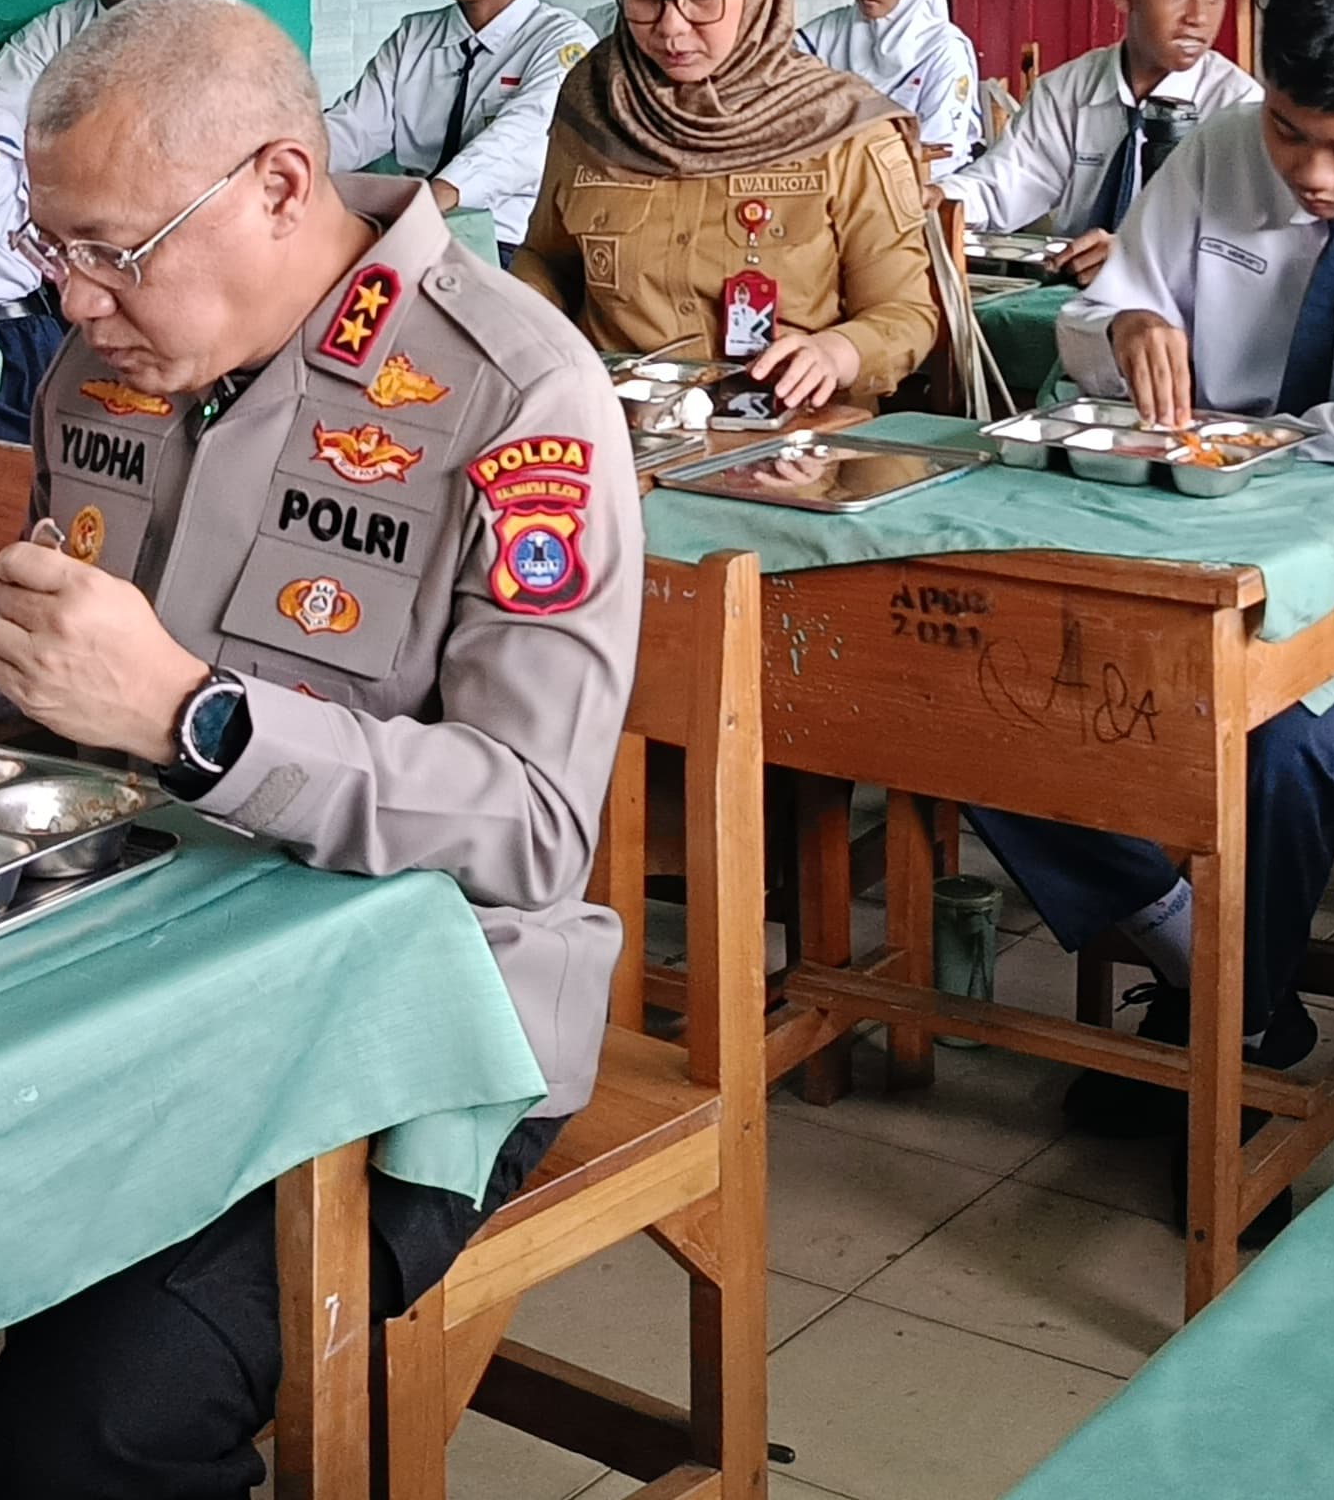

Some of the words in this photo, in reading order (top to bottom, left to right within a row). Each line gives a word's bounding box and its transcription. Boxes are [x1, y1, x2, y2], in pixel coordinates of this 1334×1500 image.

[737, 174, 819, 194] WALIKOTA
[60, 422, 147, 486] YUDHA
[478, 439, 584, 483] POLDA
[278, 487, 411, 564] POLRI
